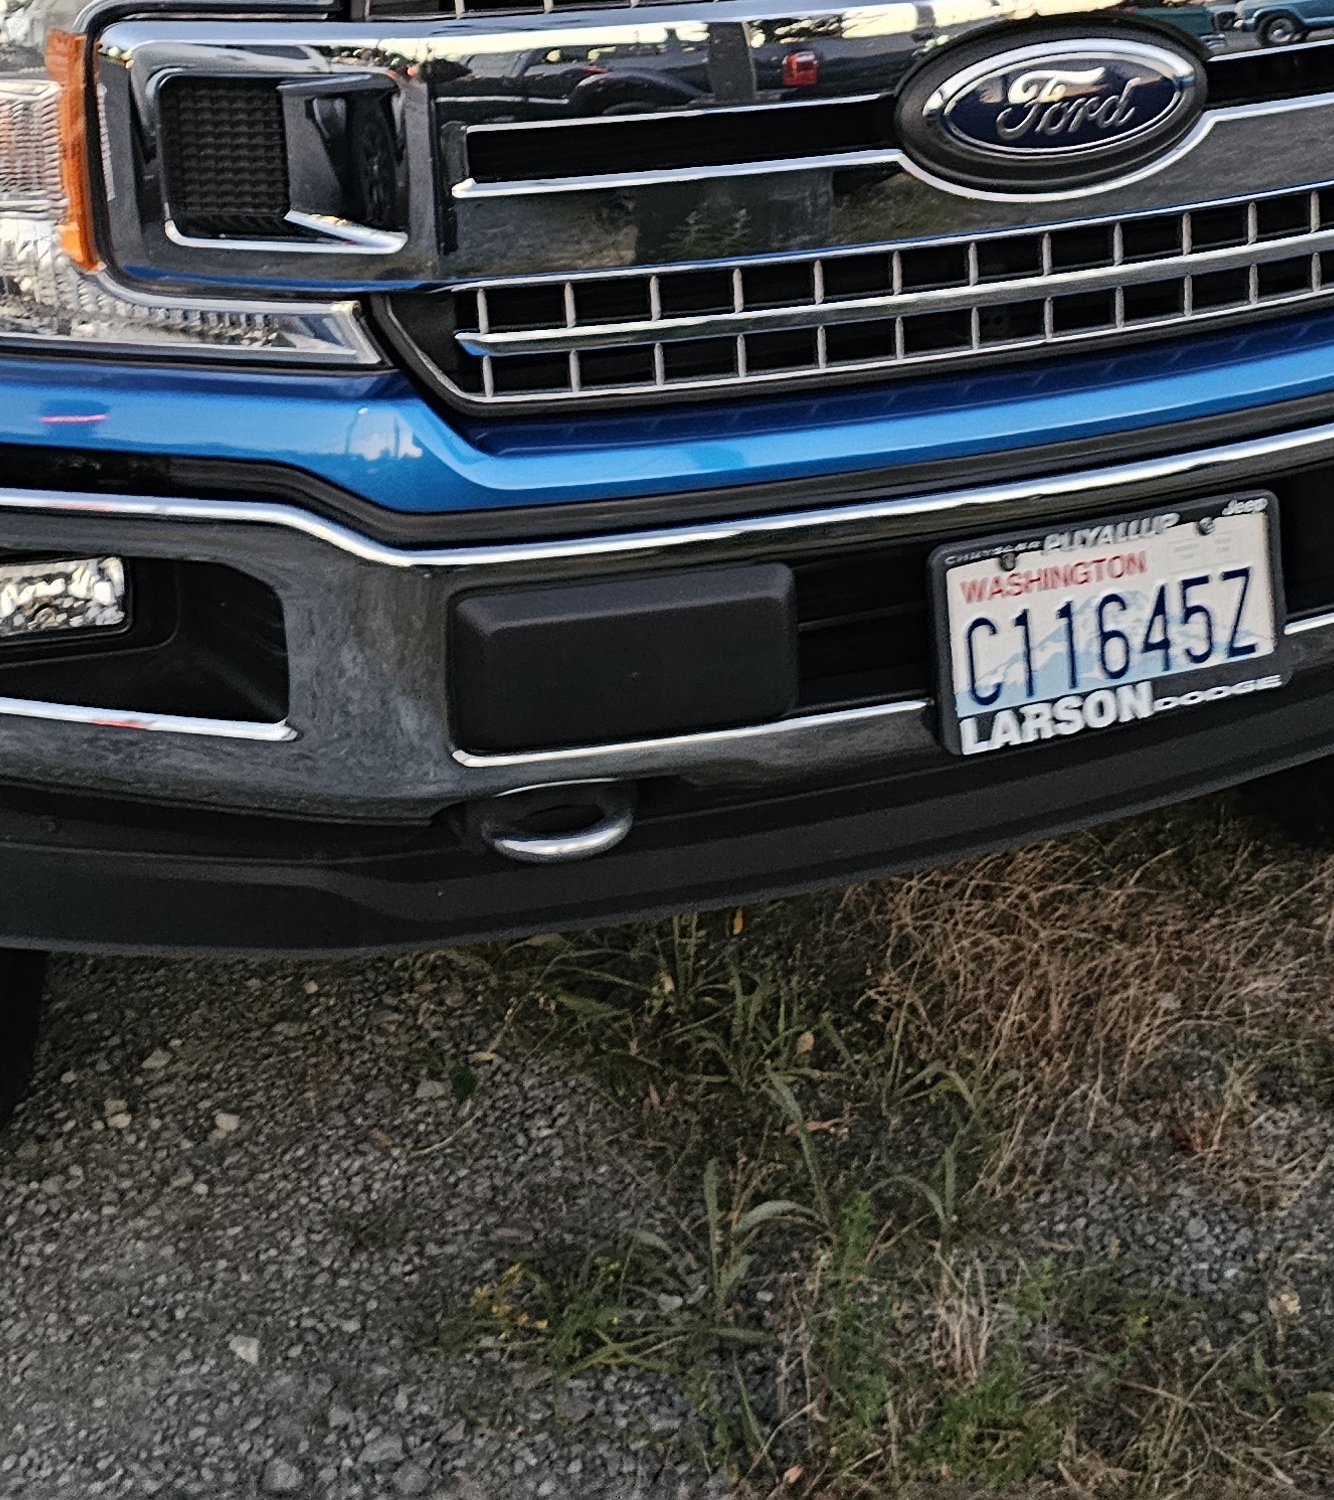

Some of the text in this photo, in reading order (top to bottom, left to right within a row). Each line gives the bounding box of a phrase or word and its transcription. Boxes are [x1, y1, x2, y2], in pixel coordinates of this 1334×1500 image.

[996, 66, 1138, 139] Ford
[1043, 513, 1181, 556] PUYALLUP
[1221, 497, 1269, 517] Jeep
[959, 549, 1149, 604] WASHINGTON
[965, 566, 1259, 706] C11645Z
[959, 674, 1283, 756] LARSON DODGE
